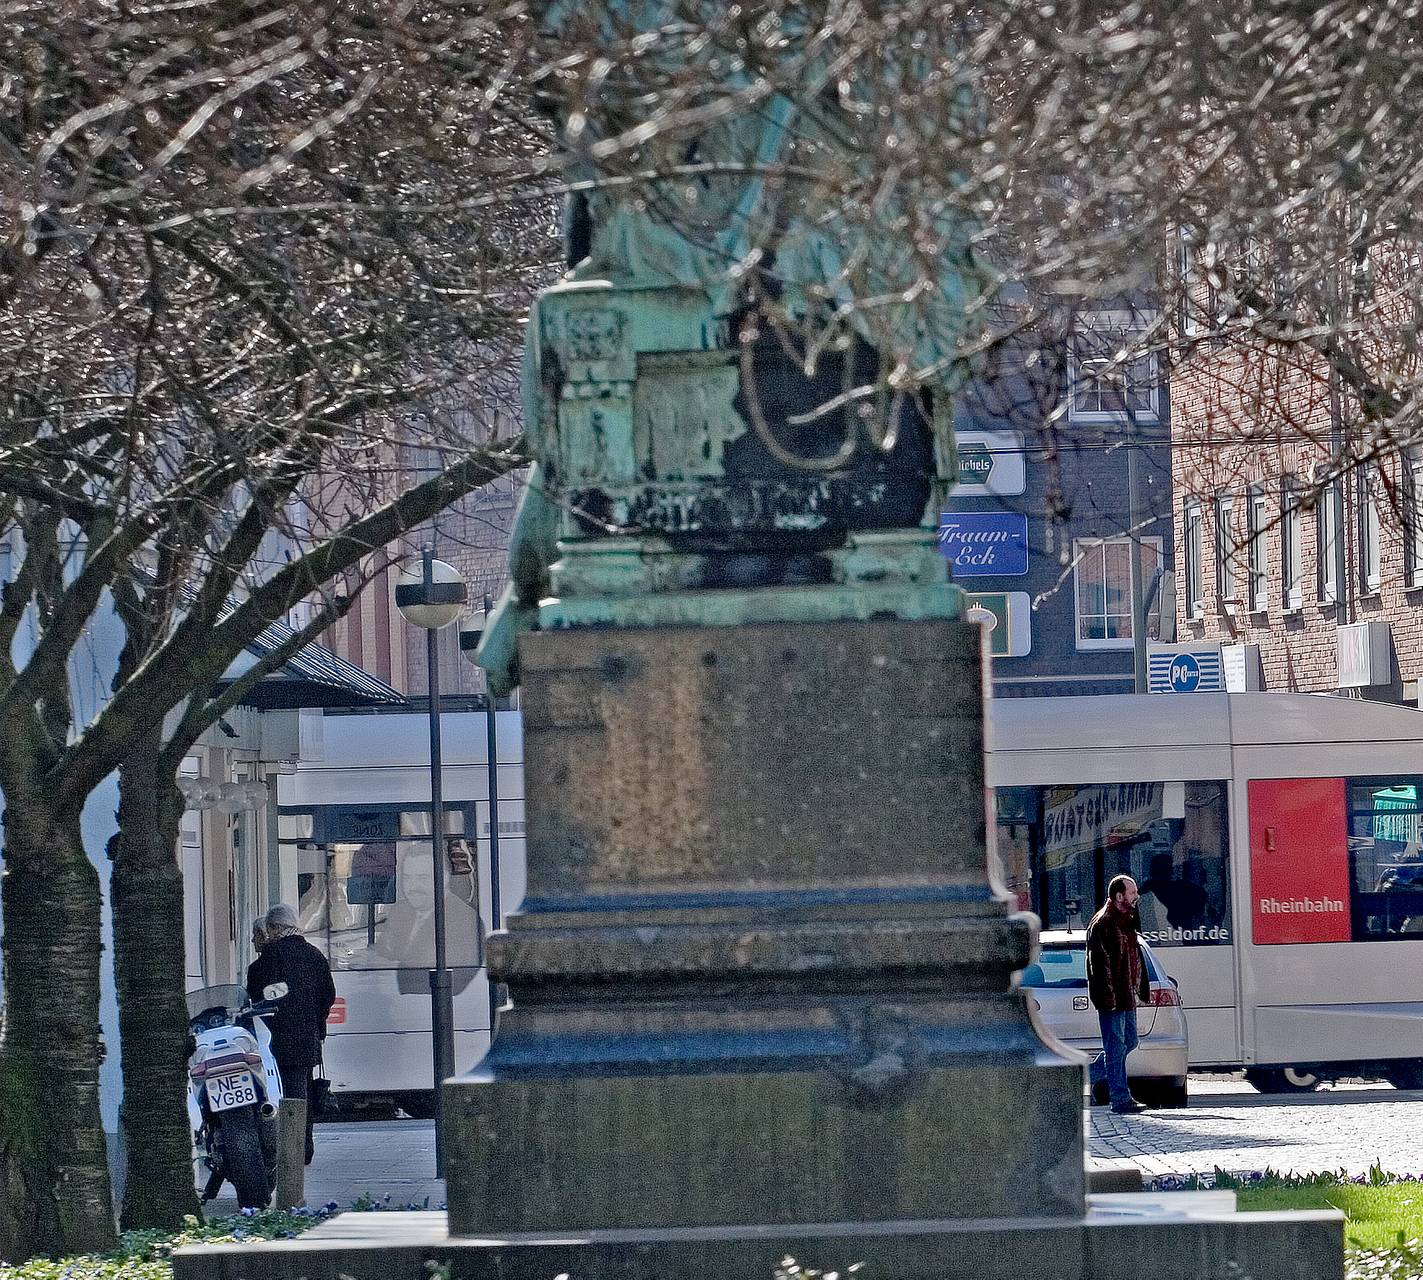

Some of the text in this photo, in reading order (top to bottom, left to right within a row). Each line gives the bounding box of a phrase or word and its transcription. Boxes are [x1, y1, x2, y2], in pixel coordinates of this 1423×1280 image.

[939, 523, 1020, 543] Traum-
[955, 545, 995, 566] Eck
[1260, 896, 1344, 914] Rheinbahn
[1141, 925, 1229, 942] sseldorf.de
[217, 1074, 242, 1093] NE
[211, 1088, 254, 1109] YG88
